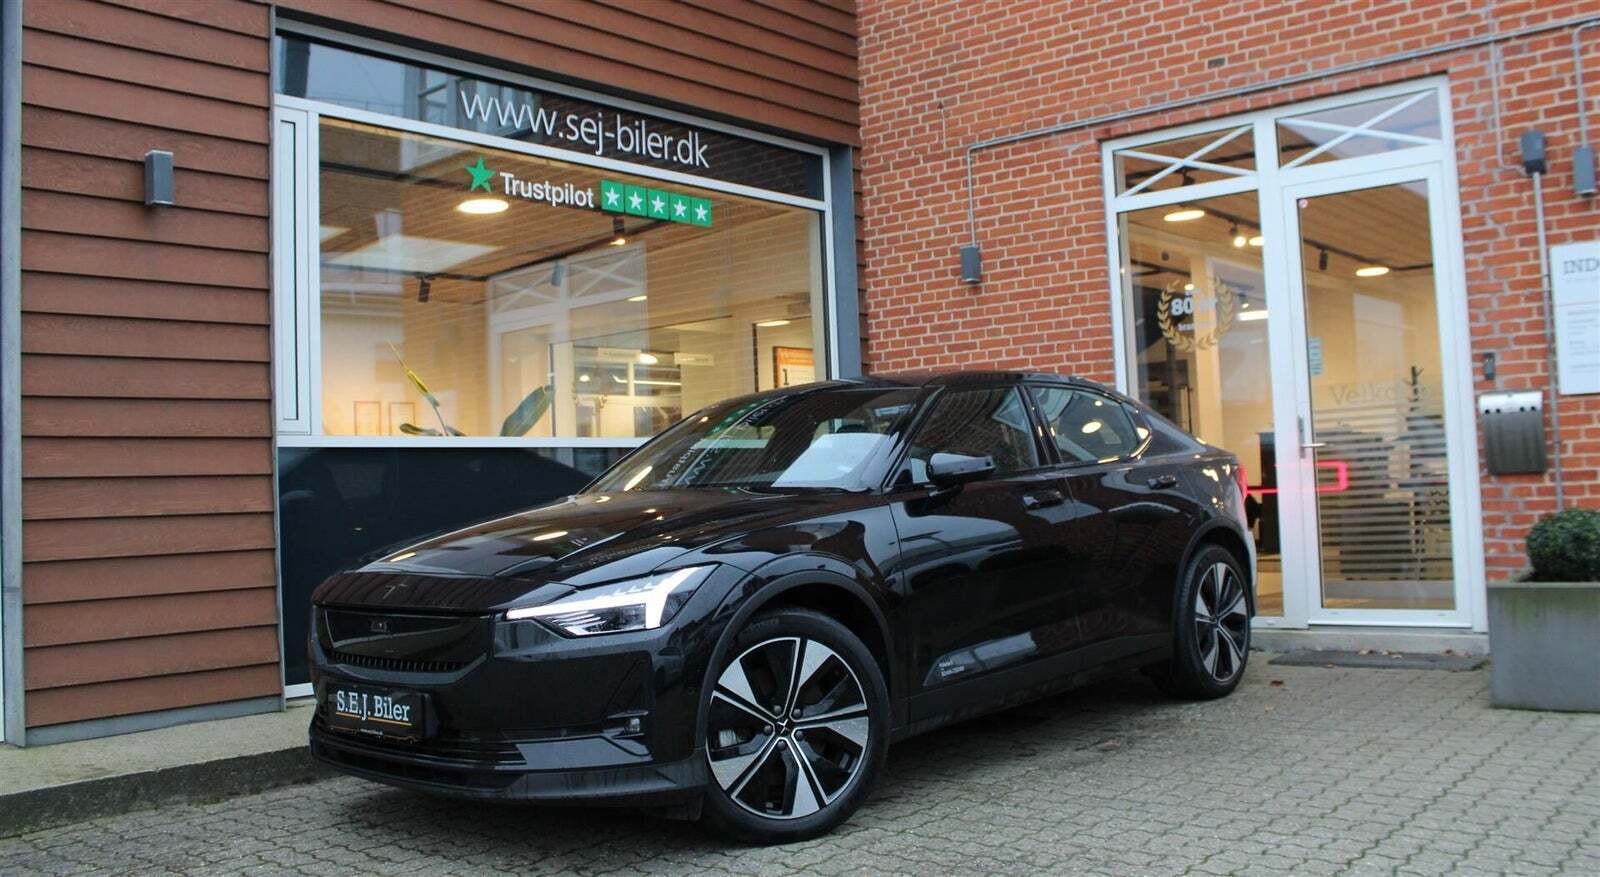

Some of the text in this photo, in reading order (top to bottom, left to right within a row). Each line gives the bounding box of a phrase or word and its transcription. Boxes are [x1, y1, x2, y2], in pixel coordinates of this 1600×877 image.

[460, 90, 710, 168] www.sej-biler.dk
[500, 171, 594, 208] Trustpilot
[336, 689, 410, 721] S.E.J. Biler
